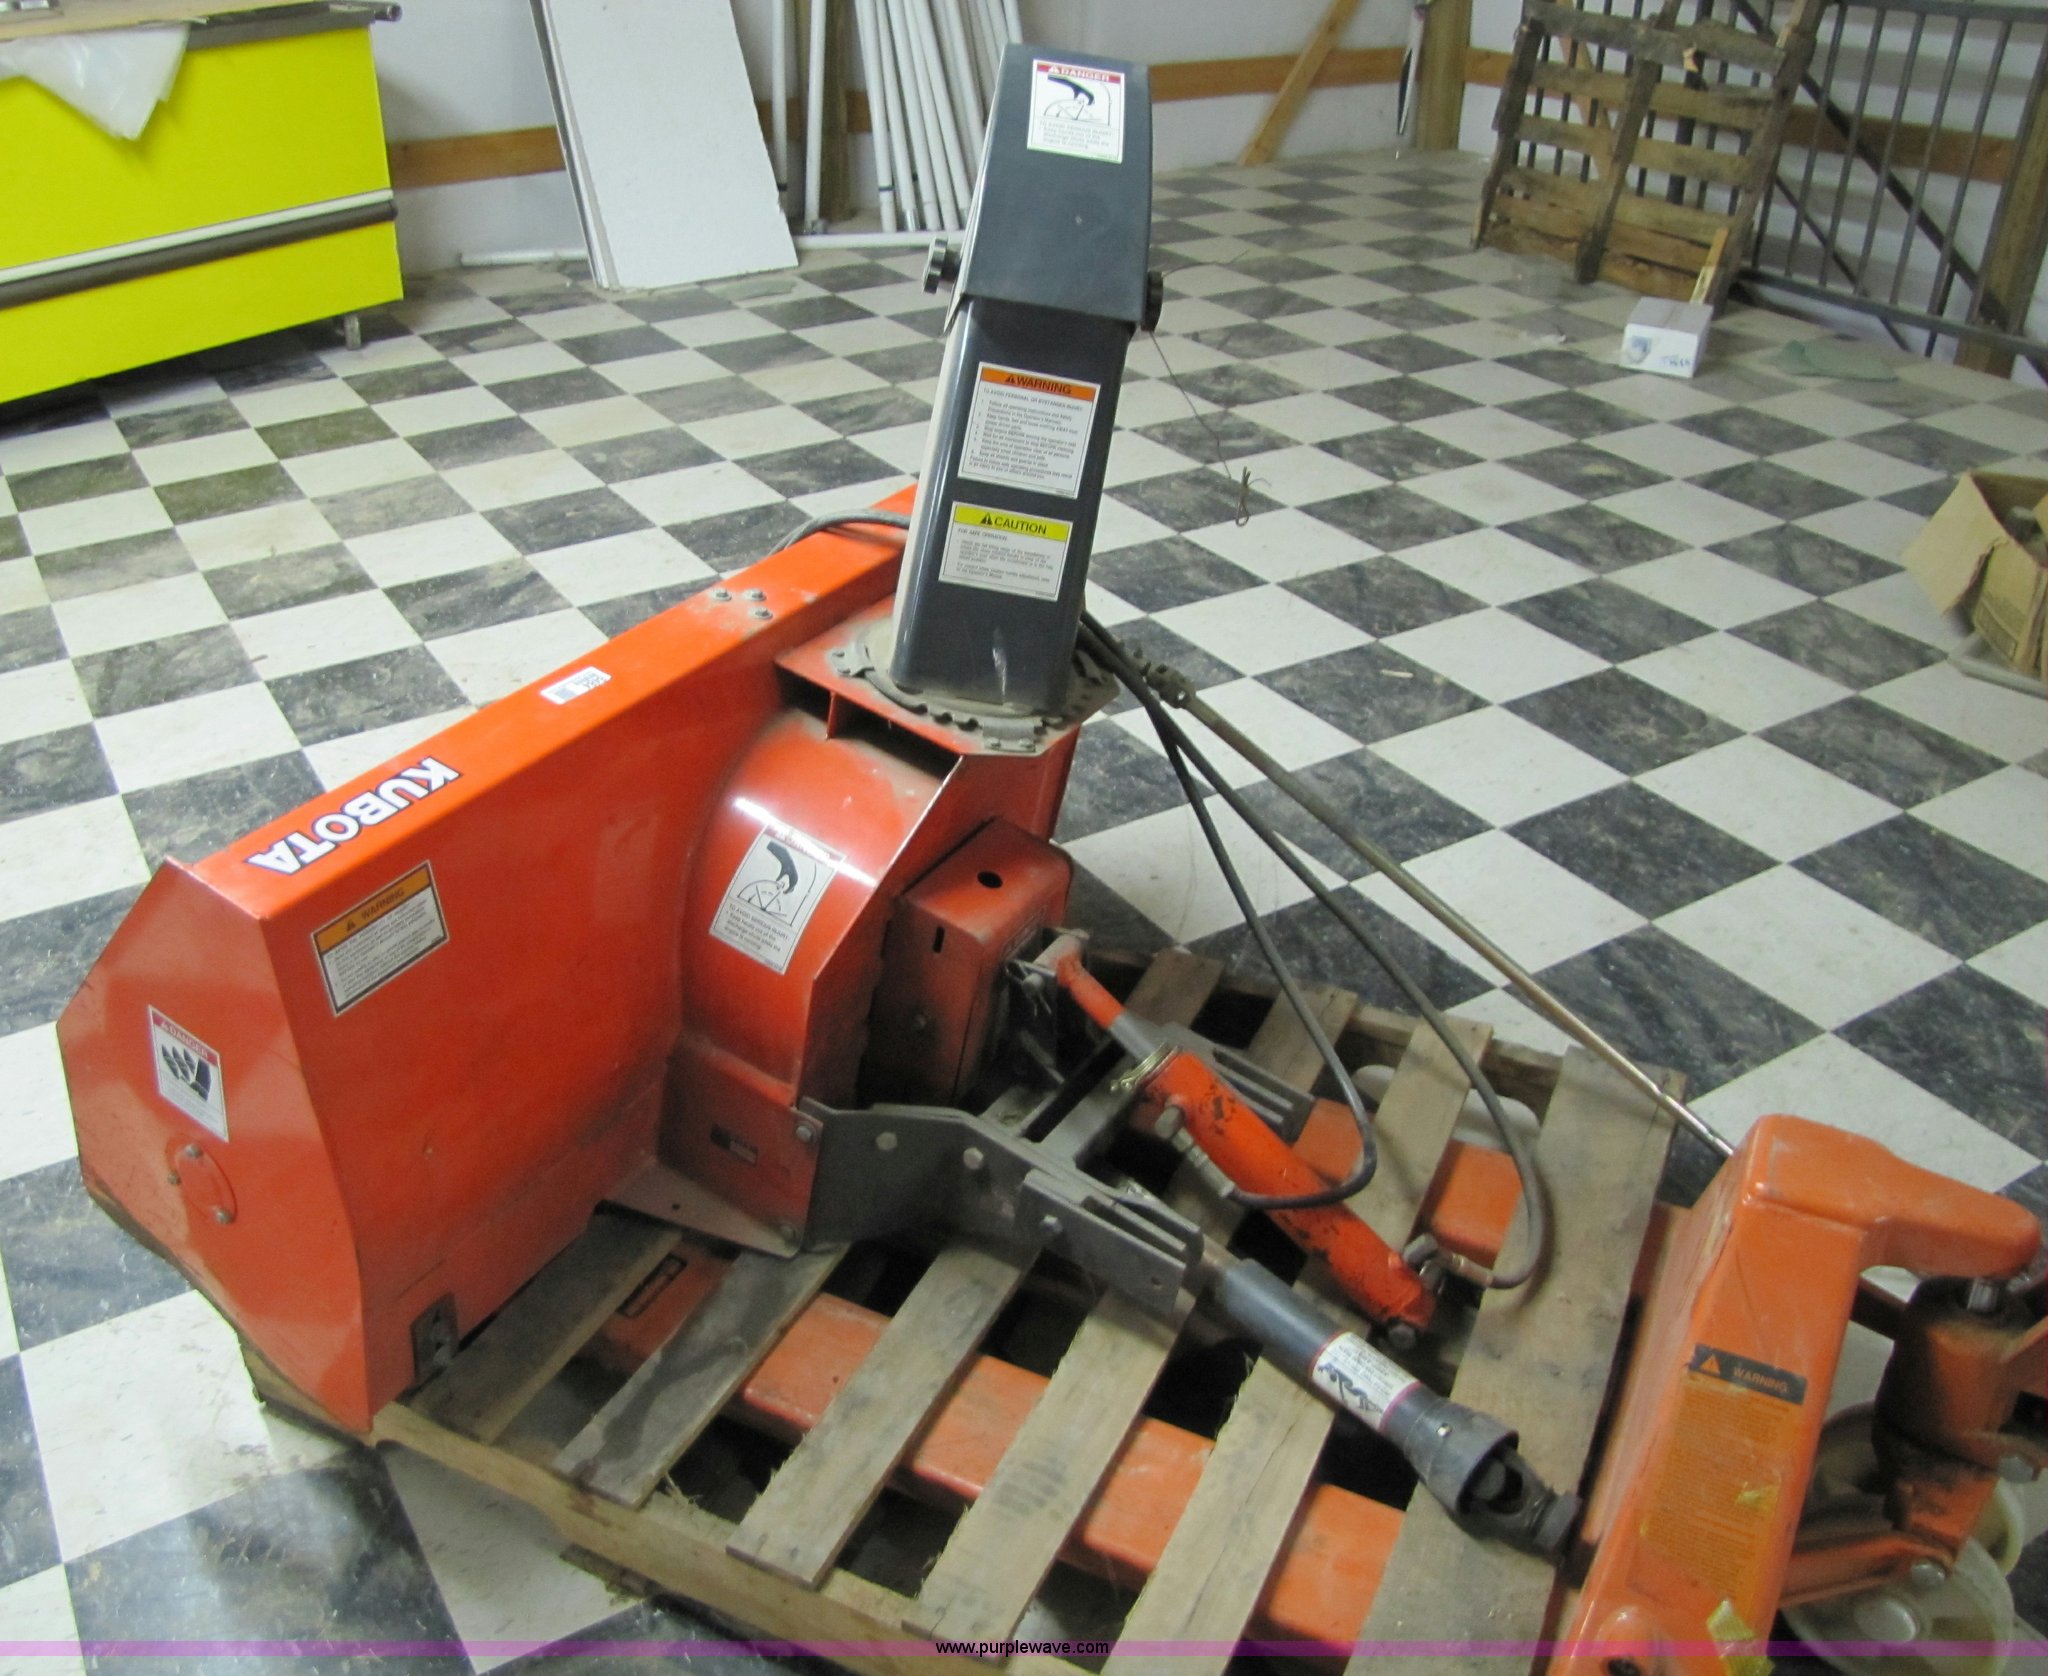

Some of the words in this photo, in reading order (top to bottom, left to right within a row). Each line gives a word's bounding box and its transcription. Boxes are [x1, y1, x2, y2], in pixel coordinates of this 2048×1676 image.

[1061, 67, 1109, 81] DANGER
[1016, 375, 1072, 395] WARNING
[993, 516, 1047, 534] CAUTION
[246, 757, 462, 875] KUBOTA
[360, 885, 405, 921] WARNING
[168, 1024, 208, 1060] DANGER
[1733, 1366, 1788, 1393] WARNING
